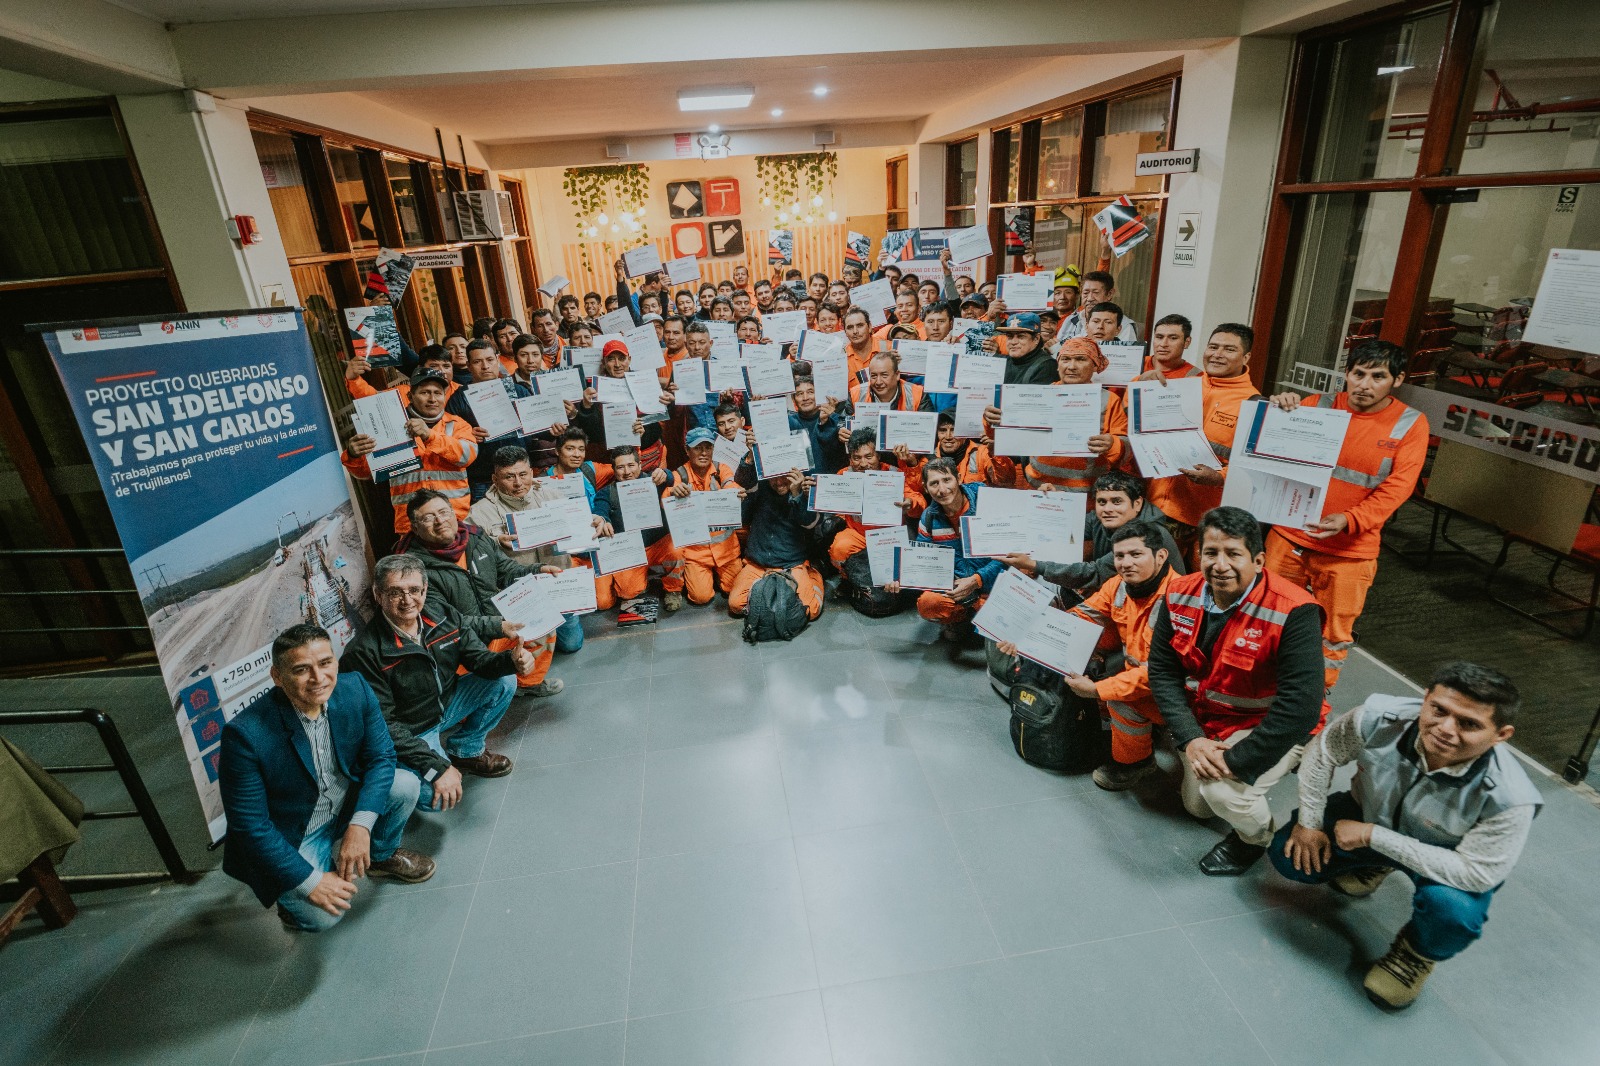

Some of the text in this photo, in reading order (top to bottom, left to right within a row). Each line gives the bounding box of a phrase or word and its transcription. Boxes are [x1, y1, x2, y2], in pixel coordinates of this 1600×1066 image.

[1140, 157, 1191, 169] AUDITORIO
[1175, 253, 1193, 261] SALIDA
[174, 320, 200, 332] ANIN
[85, 362, 278, 407] PROYECTO QUEBRADAS
[92, 400, 164, 437] SAN
[172, 374, 310, 420] IDELFONSO
[1290, 416, 1323, 426] CERTIFICADO
[100, 440, 124, 467] Y
[132, 425, 199, 461] SAN
[202, 403, 296, 443] CARLOS
[1443, 403, 1600, 472] SENCICO
[111, 423, 318, 486] ¡Trabajamos para proteger tu vida y la de miles
[115, 468, 192, 498] de Trujillanos!
[222, 651, 271, 684] +750 mil
[1020, 690, 1037, 706] CAT
